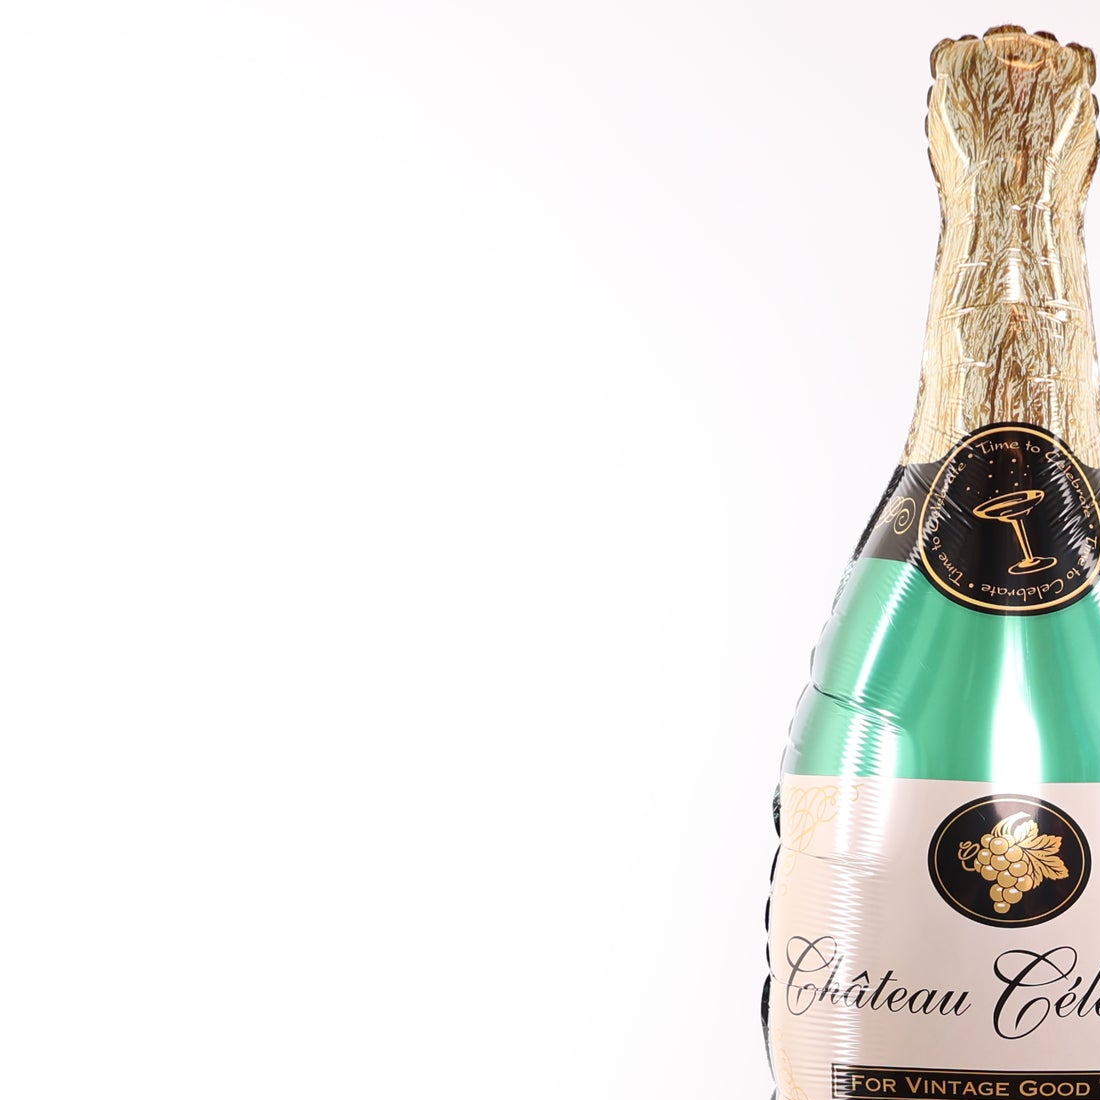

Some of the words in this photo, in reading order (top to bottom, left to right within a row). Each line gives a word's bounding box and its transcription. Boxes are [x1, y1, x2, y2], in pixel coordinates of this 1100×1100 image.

[976, 440, 1019, 454] Time
[1026, 441, 1041, 453] to
[1045, 449, 1092, 518] Celebrate
[931, 536, 942, 551] to
[1078, 536, 1098, 567] Time
[939, 552, 963, 587] Time
[1066, 569, 1080, 580] to
[981, 580, 1065, 602] Celebrate
[785, 935, 972, 1016] Château
[905, 1076, 1010, 1097] VINTAGE
[1019, 1079, 1091, 1097] GOOD
